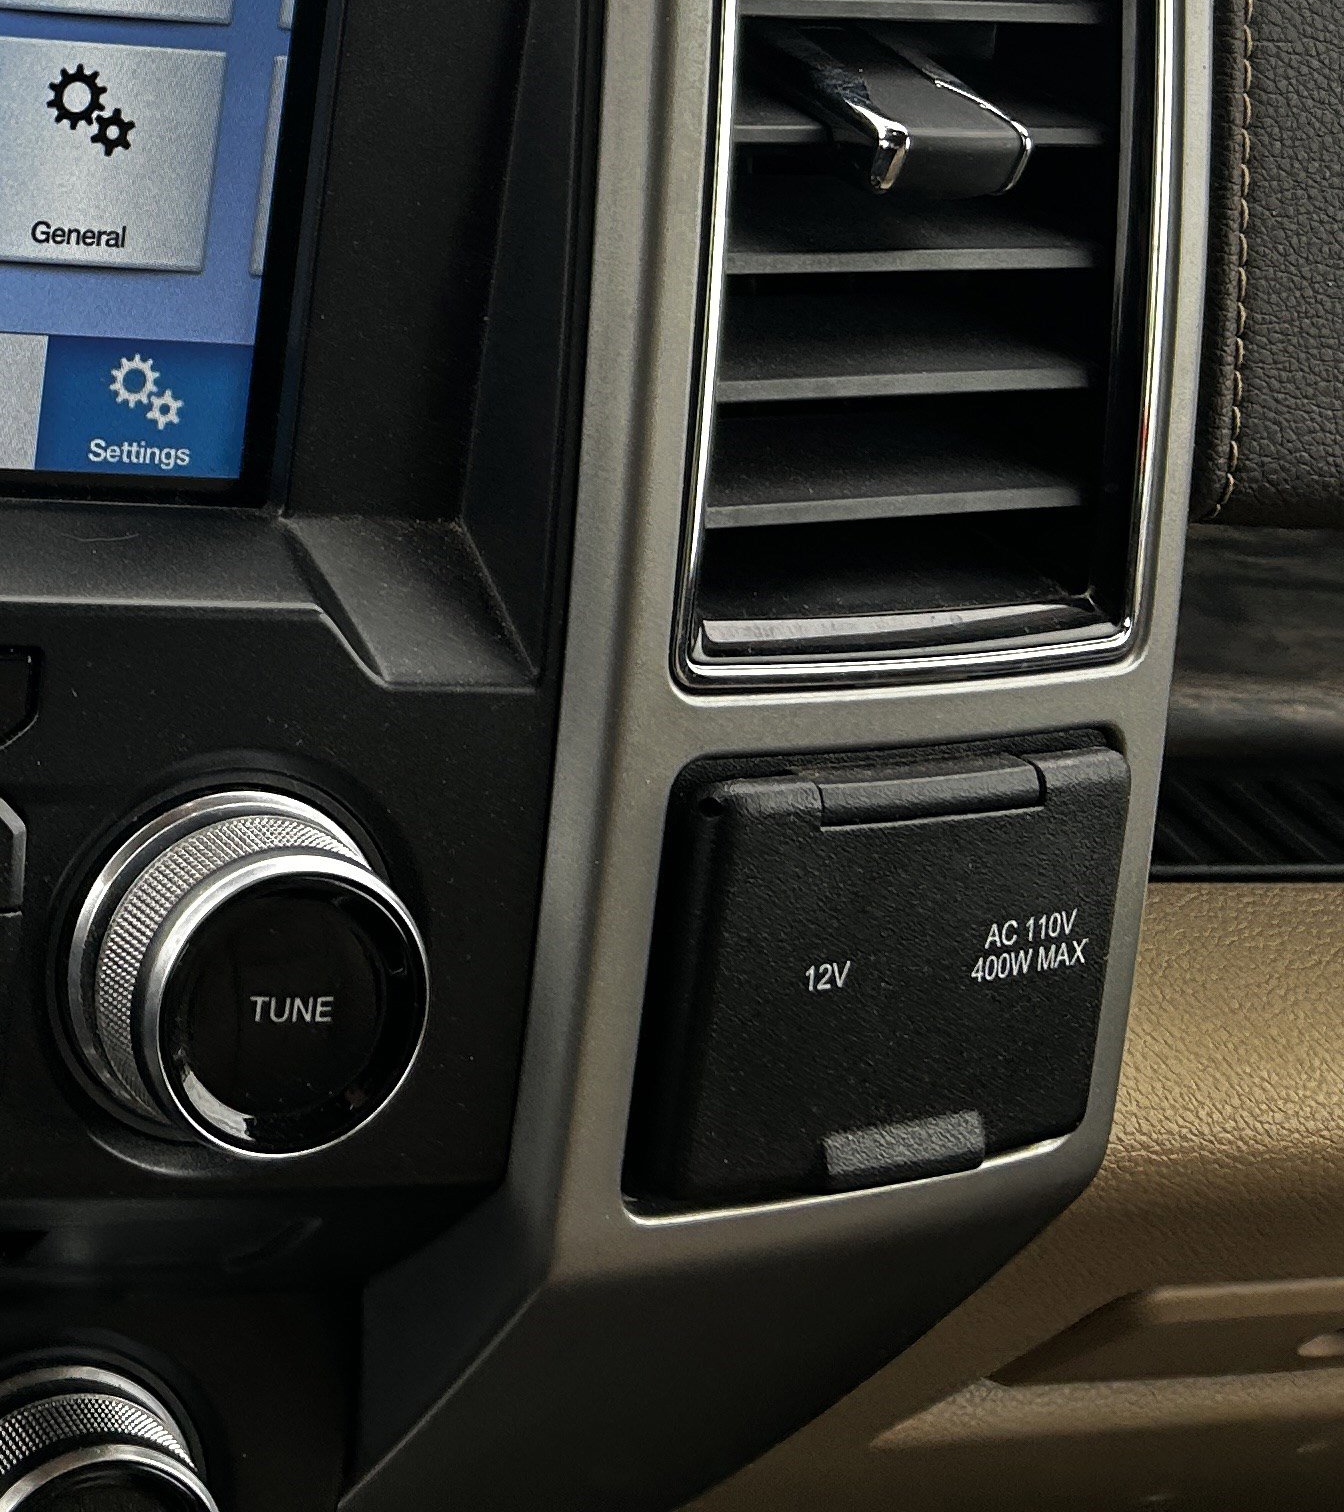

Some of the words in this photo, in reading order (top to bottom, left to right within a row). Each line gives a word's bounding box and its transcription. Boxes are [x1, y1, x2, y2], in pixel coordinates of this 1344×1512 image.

[30, 220, 127, 249] General
[87, 438, 190, 470] Settings
[984, 919, 1019, 950] AC
[1025, 908, 1078, 942] 110V
[805, 960, 851, 992] 12V
[970, 948, 1033, 983] 400W
[1037, 938, 1089, 972] MAX
[249, 996, 334, 1023] TUNE
